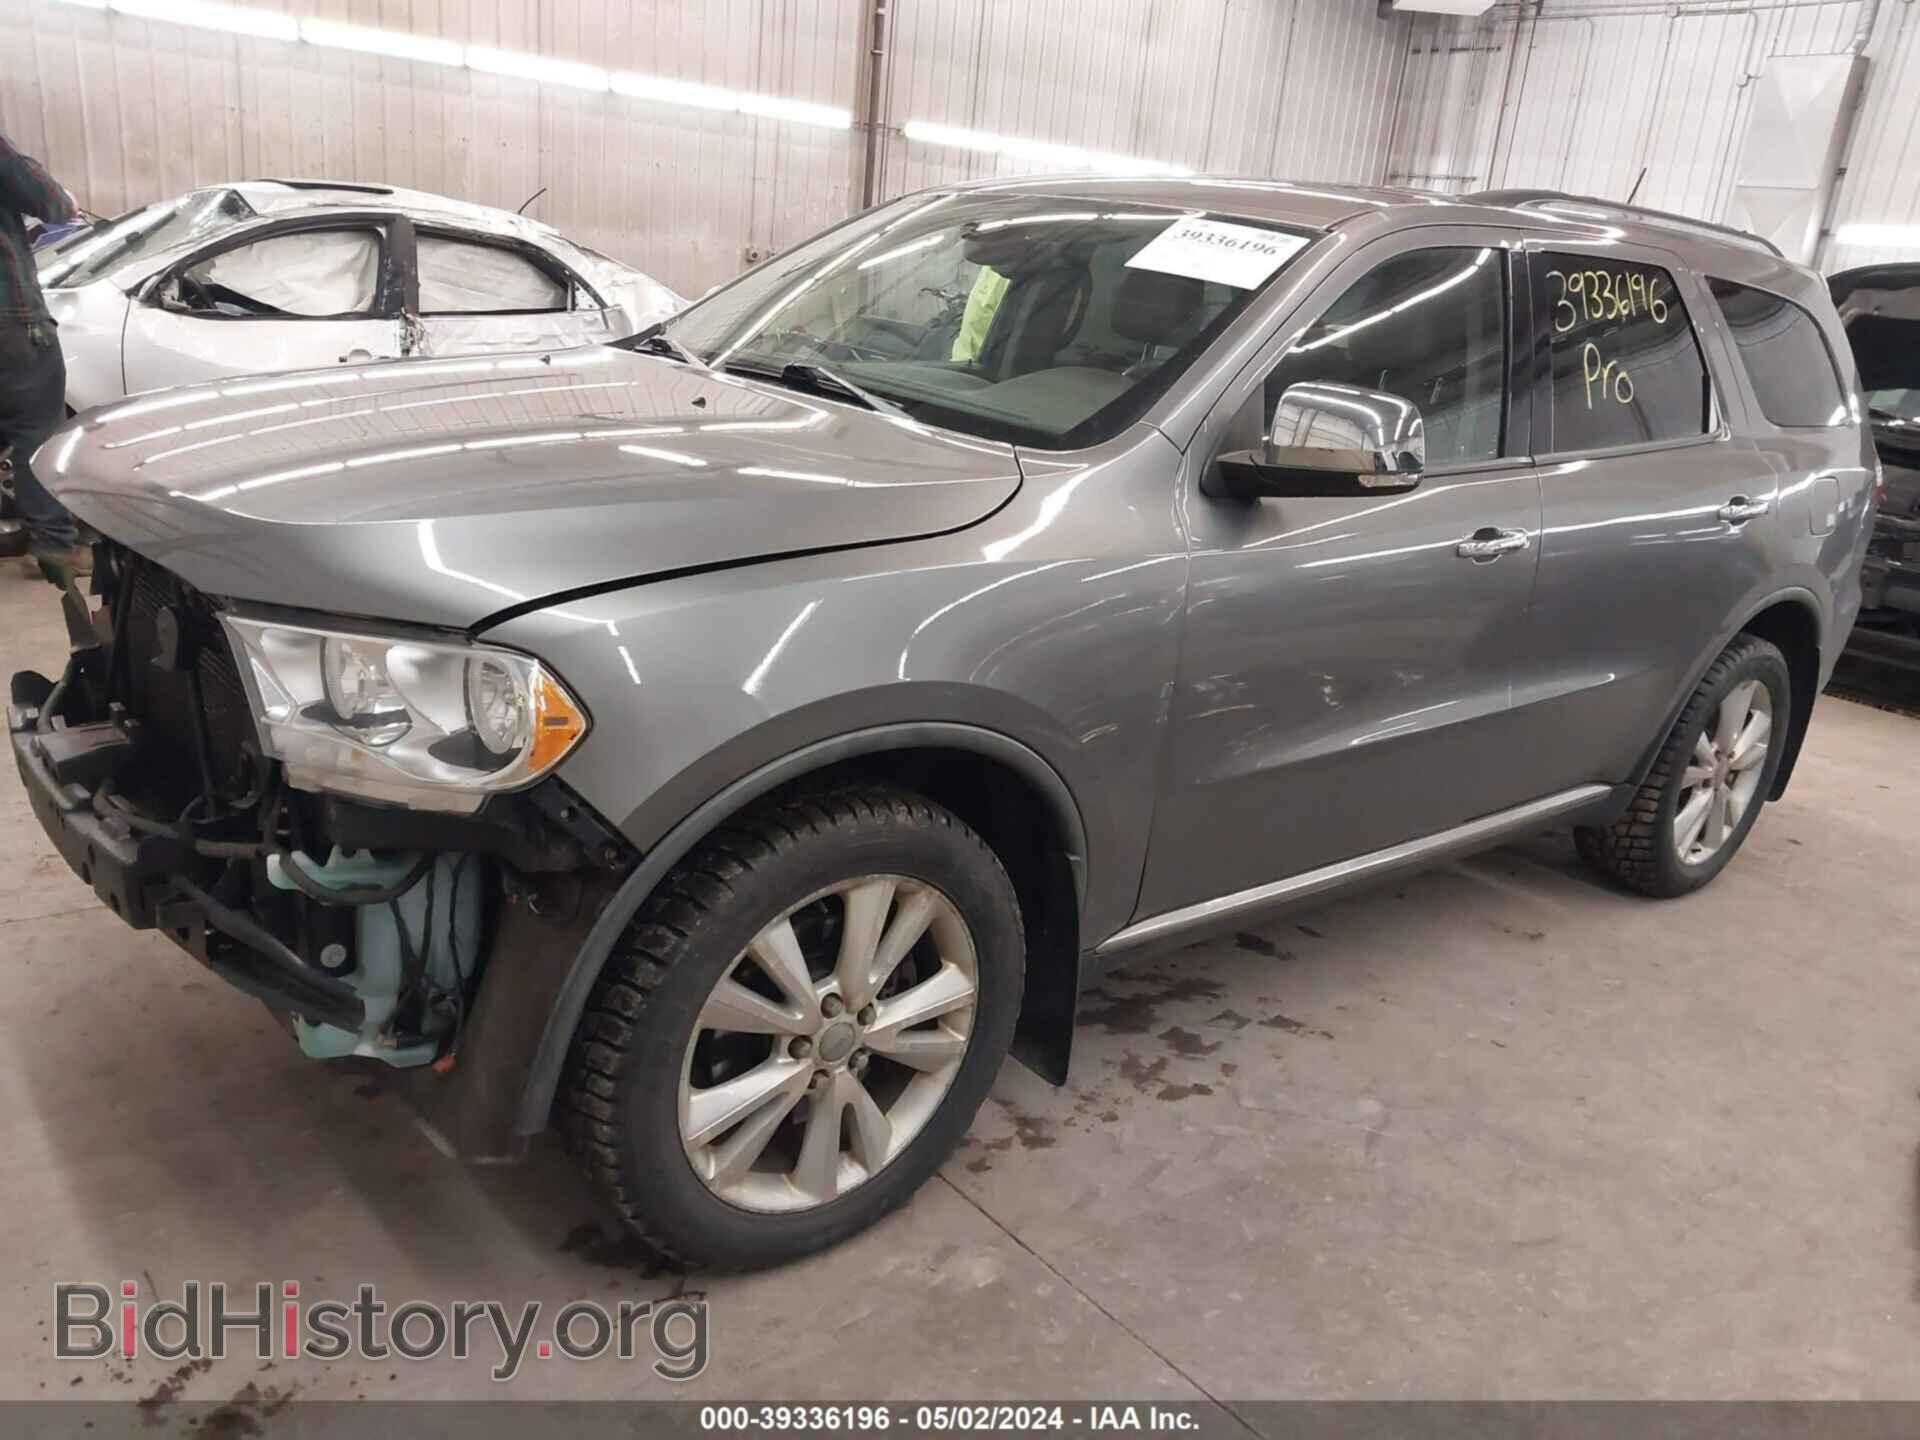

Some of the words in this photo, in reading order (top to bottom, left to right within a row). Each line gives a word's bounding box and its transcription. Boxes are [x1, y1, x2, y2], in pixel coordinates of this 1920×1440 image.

[1174, 228, 1277, 256] 39336196
[1546, 270, 1668, 332] 39336196
[1583, 342, 1634, 410] Pro
